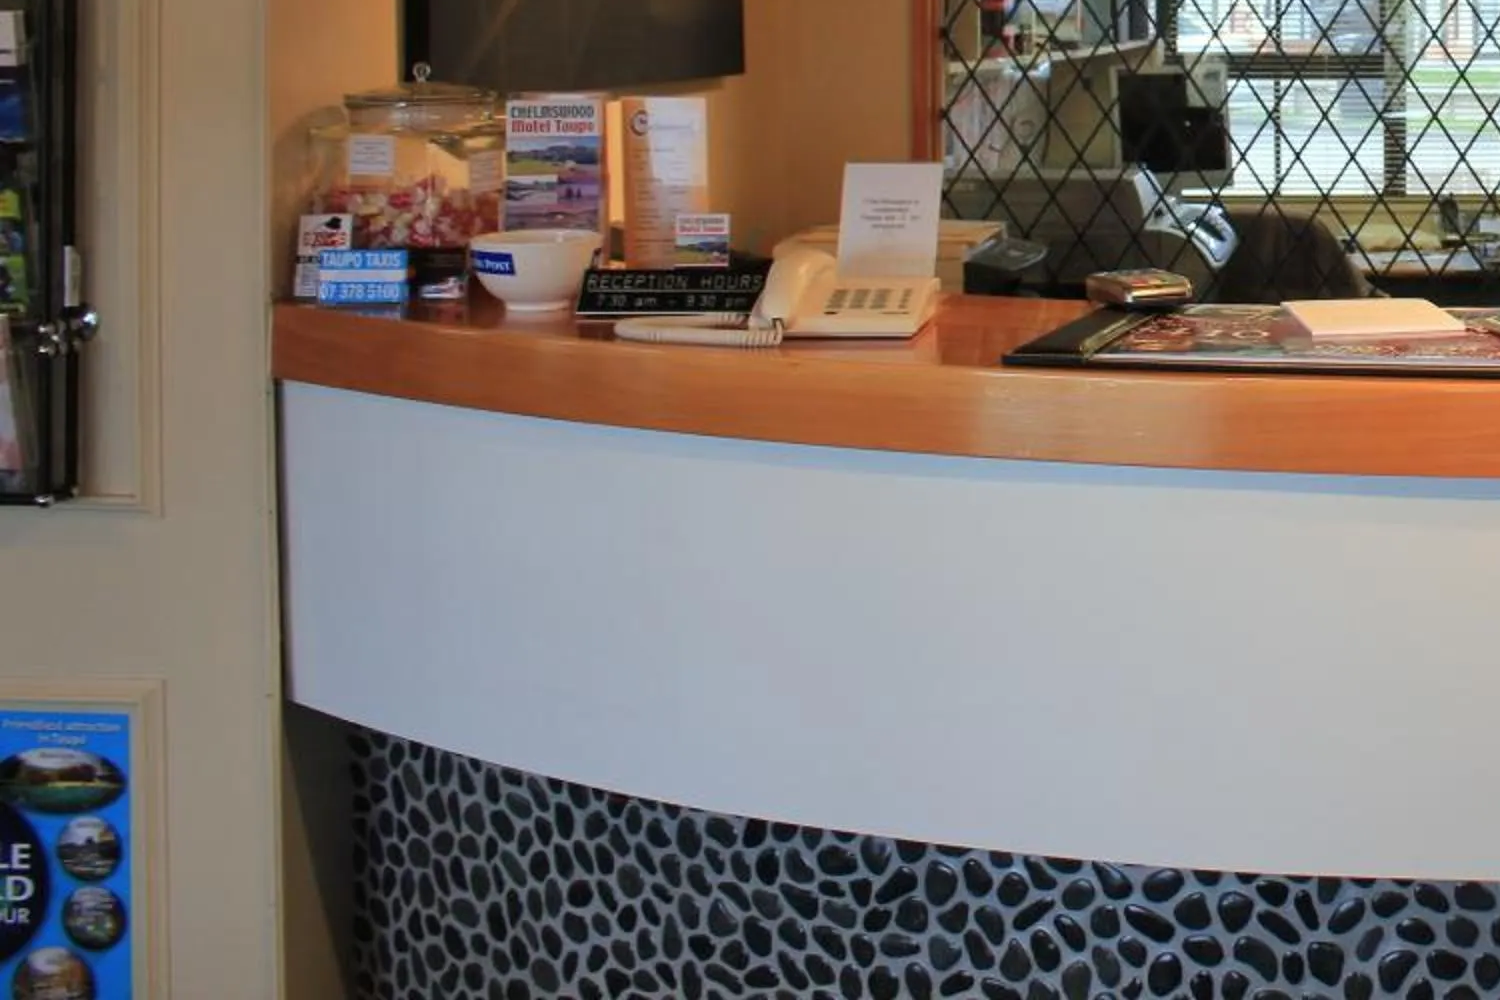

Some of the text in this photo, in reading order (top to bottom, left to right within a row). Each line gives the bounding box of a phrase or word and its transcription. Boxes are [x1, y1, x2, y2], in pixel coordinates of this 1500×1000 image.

[511, 119, 594, 134] Motel Taupo
[322, 251, 361, 267] TAUPO
[365, 251, 400, 267] TAXIS
[587, 273, 763, 291] RECEPTION HOURS
[320, 283, 337, 300] 07
[339, 284, 364, 299] 378
